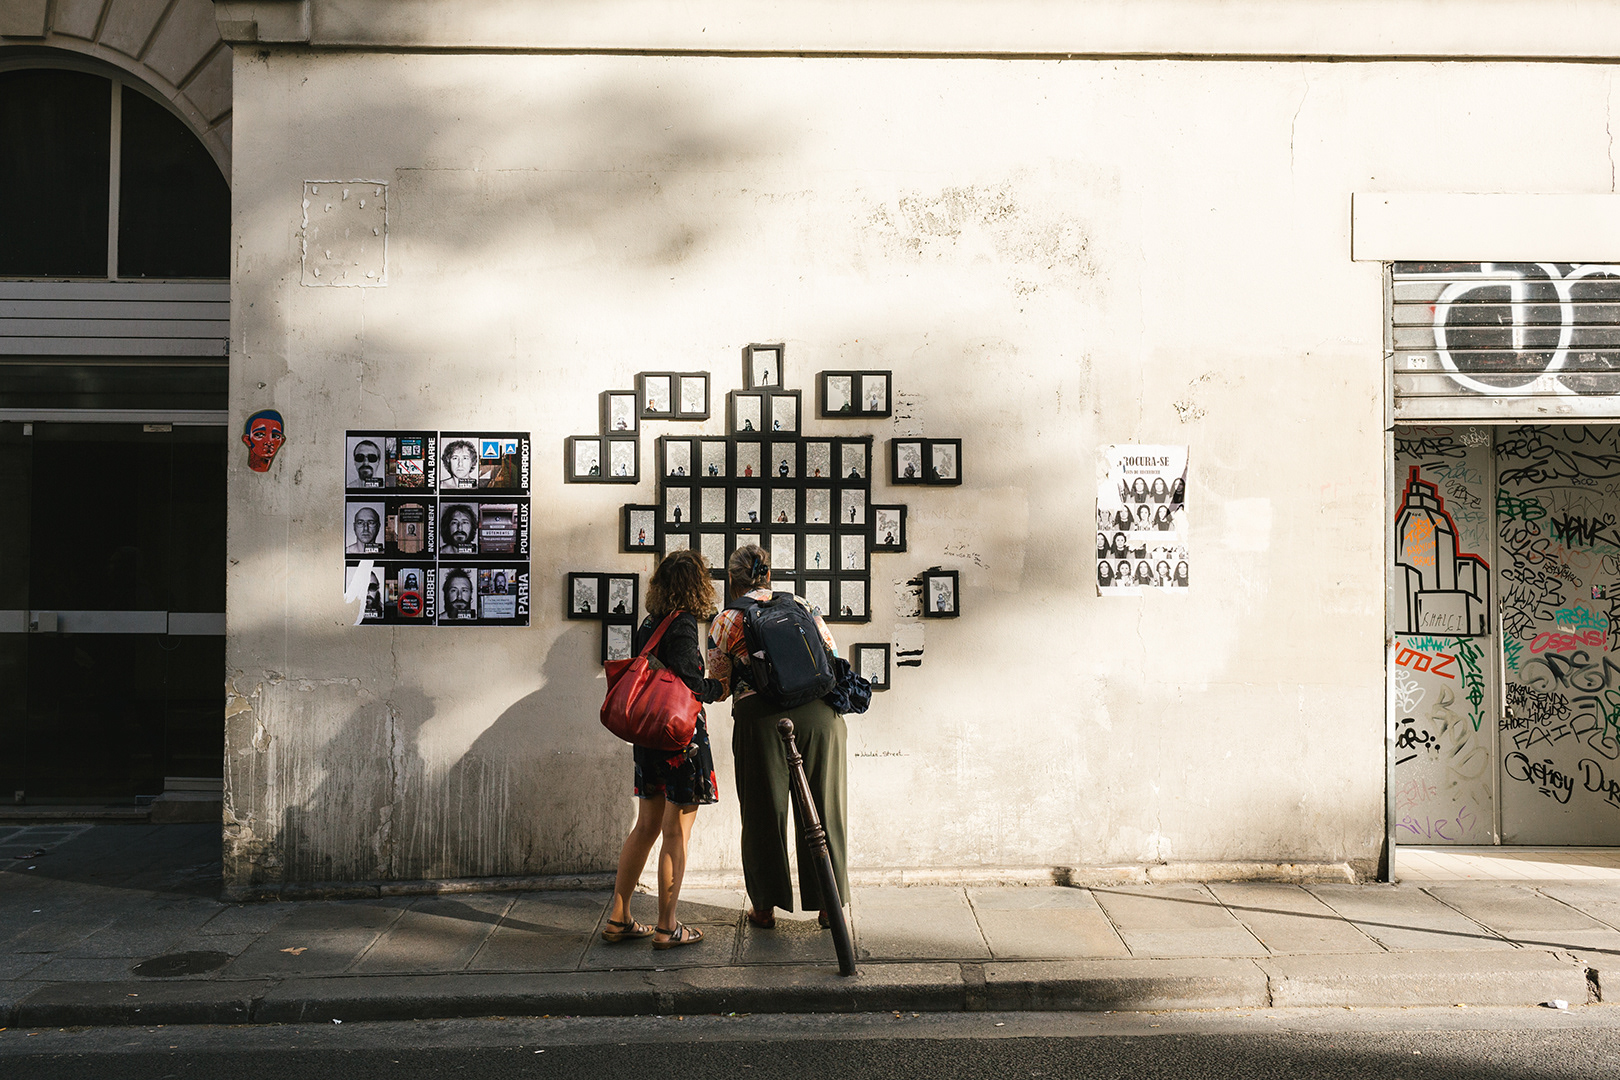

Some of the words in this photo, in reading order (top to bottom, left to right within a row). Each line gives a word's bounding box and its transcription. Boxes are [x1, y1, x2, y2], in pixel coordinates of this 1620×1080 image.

[427, 437, 436, 467] BARRE
[521, 438, 530, 489] BOURRICOT
[1117, 455, 1170, 467] ROCURA-SE
[427, 467, 436, 488] MAL
[427, 504, 436, 553] INCONTINENT
[520, 503, 529, 554] POUILLEUX
[425, 569, 436, 618] CLUBBER
[518, 573, 529, 615] PARIA
